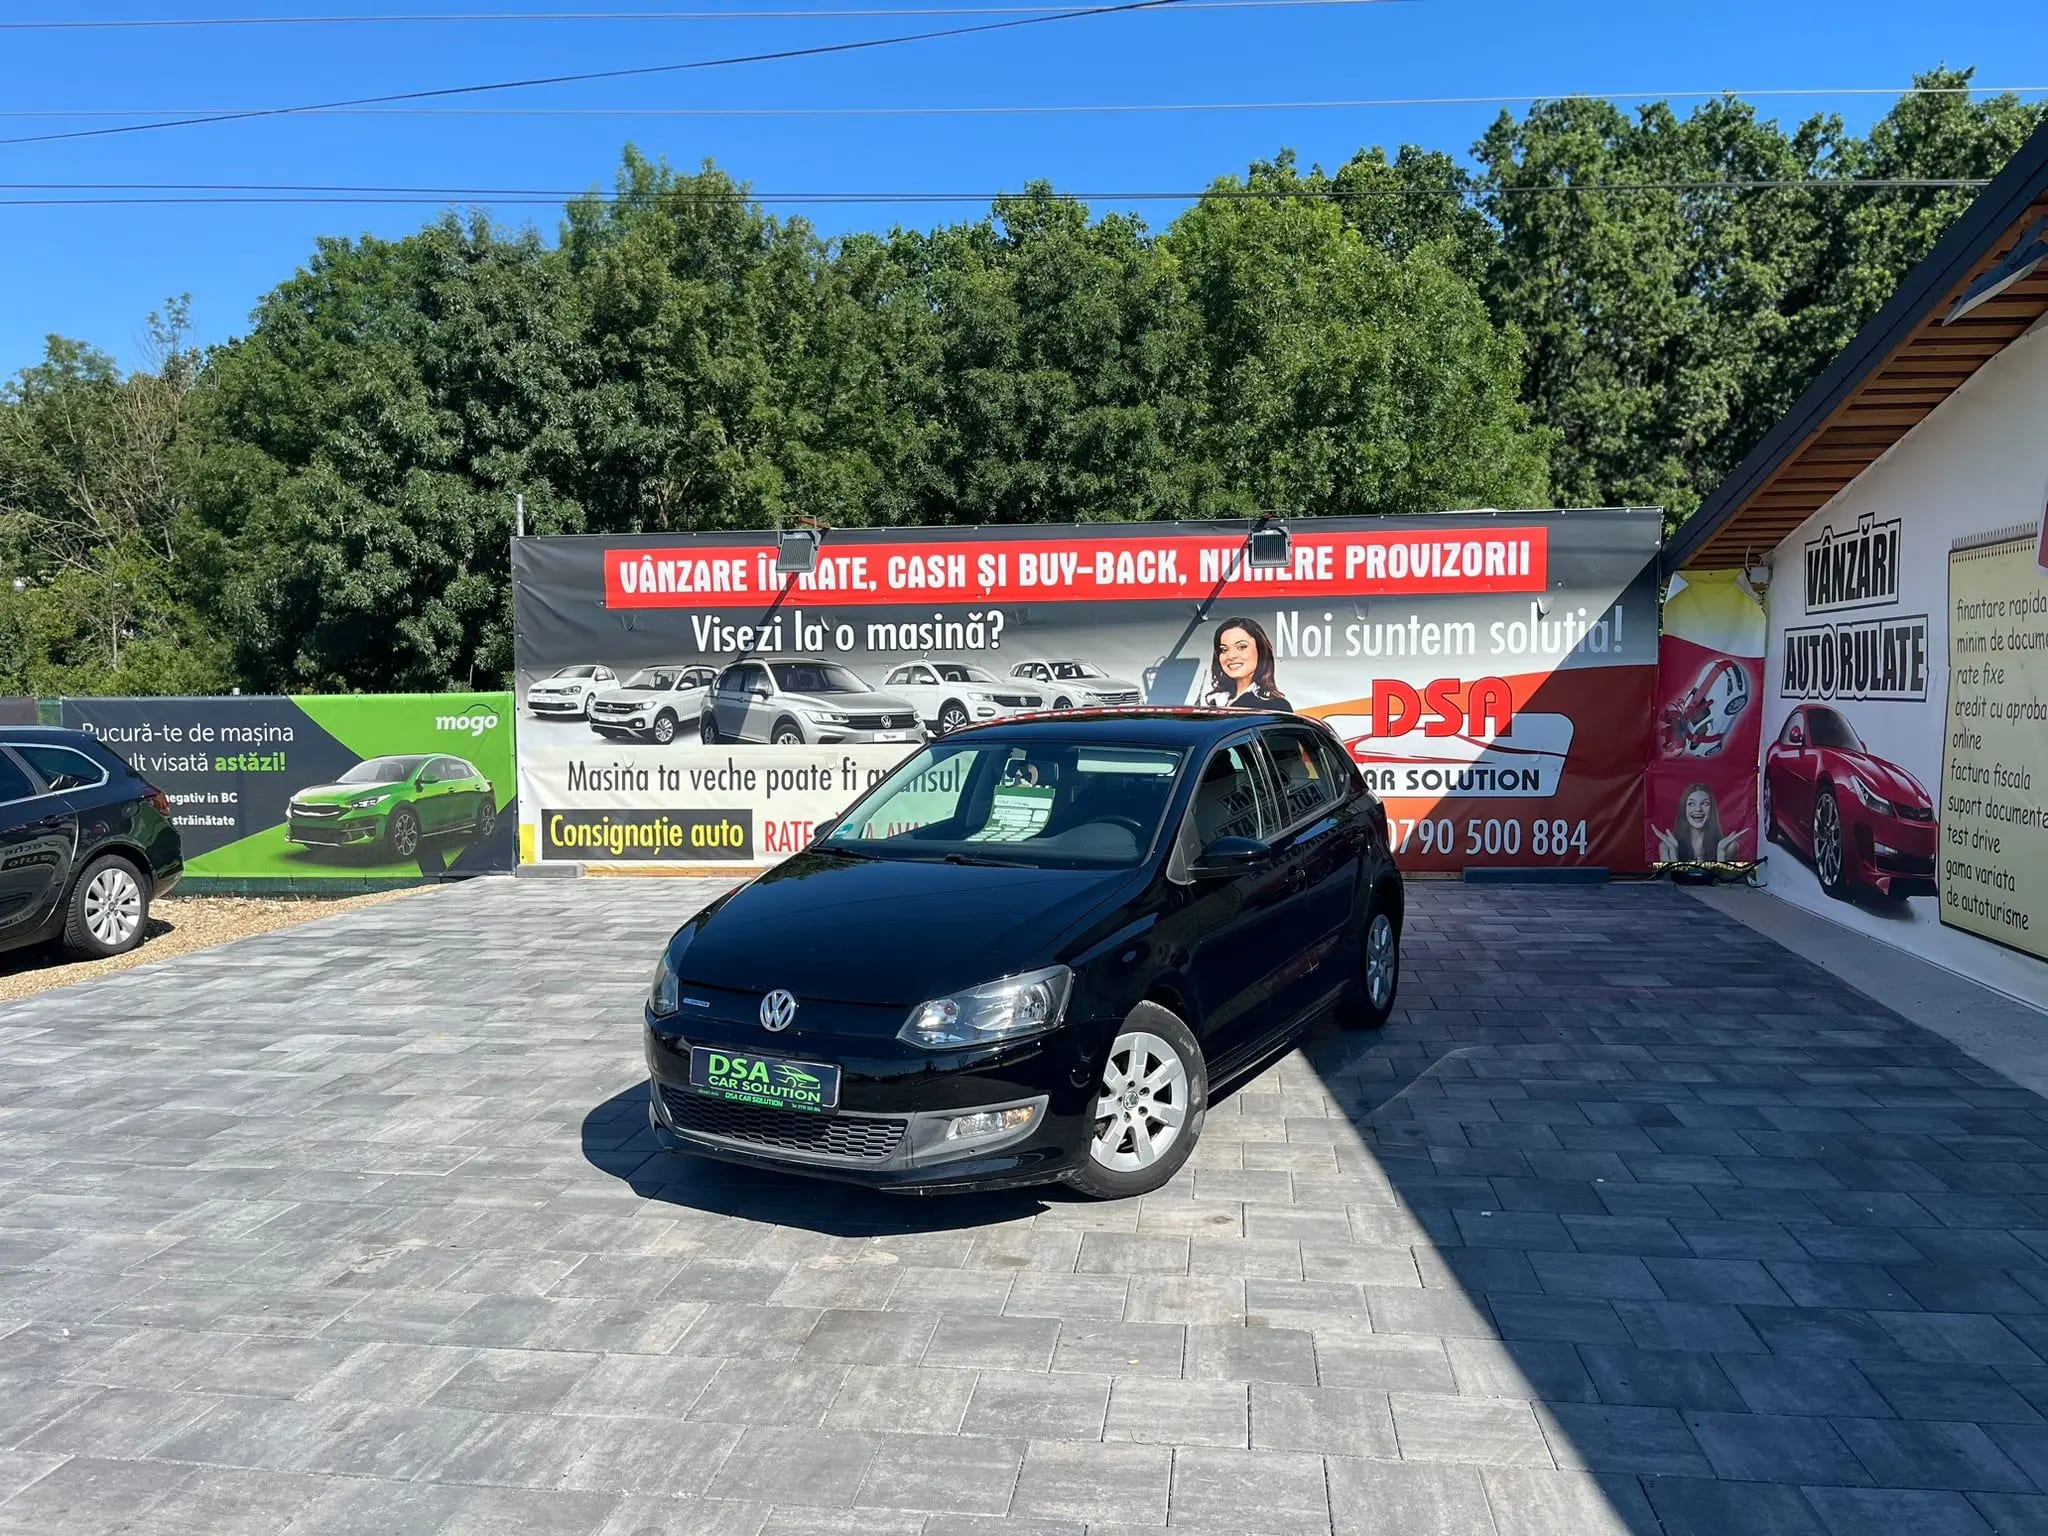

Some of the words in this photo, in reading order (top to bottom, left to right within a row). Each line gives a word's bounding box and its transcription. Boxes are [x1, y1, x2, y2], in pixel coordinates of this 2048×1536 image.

[619, 554, 748, 594] VÂNZARE
[888, 554, 967, 588] CASH
[977, 553, 1007, 596] ȘI
[1018, 548, 1187, 586] BUY-BACK,
[1345, 540, 1530, 579] PROVIZORII
[1807, 523, 1897, 607] VÂNZĂRI
[1957, 598, 2005, 622] finantare
[2009, 589, 2048, 622] rapida
[690, 614, 783, 653] Visezi
[794, 610, 823, 652] la
[834, 623, 855, 652] o
[867, 609, 1004, 658] mașină?
[1275, 610, 1334, 658] Noi
[1345, 613, 1476, 657] suntem
[1489, 601, 1623, 655] solutia!
[1956, 630, 1987, 653] minim
[1989, 627, 2004, 651] de
[1784, 632, 1836, 692] AUTO
[1839, 625, 1924, 692] RULATE
[1956, 664, 1979, 685] rate
[1983, 662, 2005, 685] fixe
[1372, 676, 1513, 738] DSA
[1954, 696, 1987, 718] credit
[1989, 704, 2003, 718] cu
[189, 722, 215, 743] de
[220, 722, 294, 746] mașina
[435, 715, 499, 737] mogo
[1952, 728, 1982, 750] online
[151, 752, 209, 772] visată
[214, 752, 287, 772] astăzi!
[567, 761, 649, 792] Masina
[658, 764, 680, 792] ta
[689, 757, 757, 792] veche
[766, 764, 833, 799] poate
[842, 757, 857, 791] fi
[1951, 758, 1990, 785] factura
[1994, 762, 2032, 791] fiscala
[1406, 769, 1540, 791] SOLUTION
[207, 792, 219, 804] in
[221, 792, 239, 804] BC
[1947, 795, 1983, 820] suport
[1984, 796, 2048, 829] documente
[172, 814, 236, 826] străinătate
[550, 814, 683, 856] Consignație
[691, 819, 744, 848] auto
[1465, 818, 1522, 856] 500
[1531, 819, 1588, 856] 884
[1946, 823, 1969, 846] test
[1972, 827, 2001, 854] drive
[1945, 859, 1972, 881] gama
[1975, 865, 2016, 892] variata
[1946, 885, 1959, 908] de
[1961, 894, 2030, 931] autoturisme
[708, 1054, 770, 1083] DSA
[708, 1075, 739, 1090] CAR
[741, 1080, 822, 1104] SOLUTION
